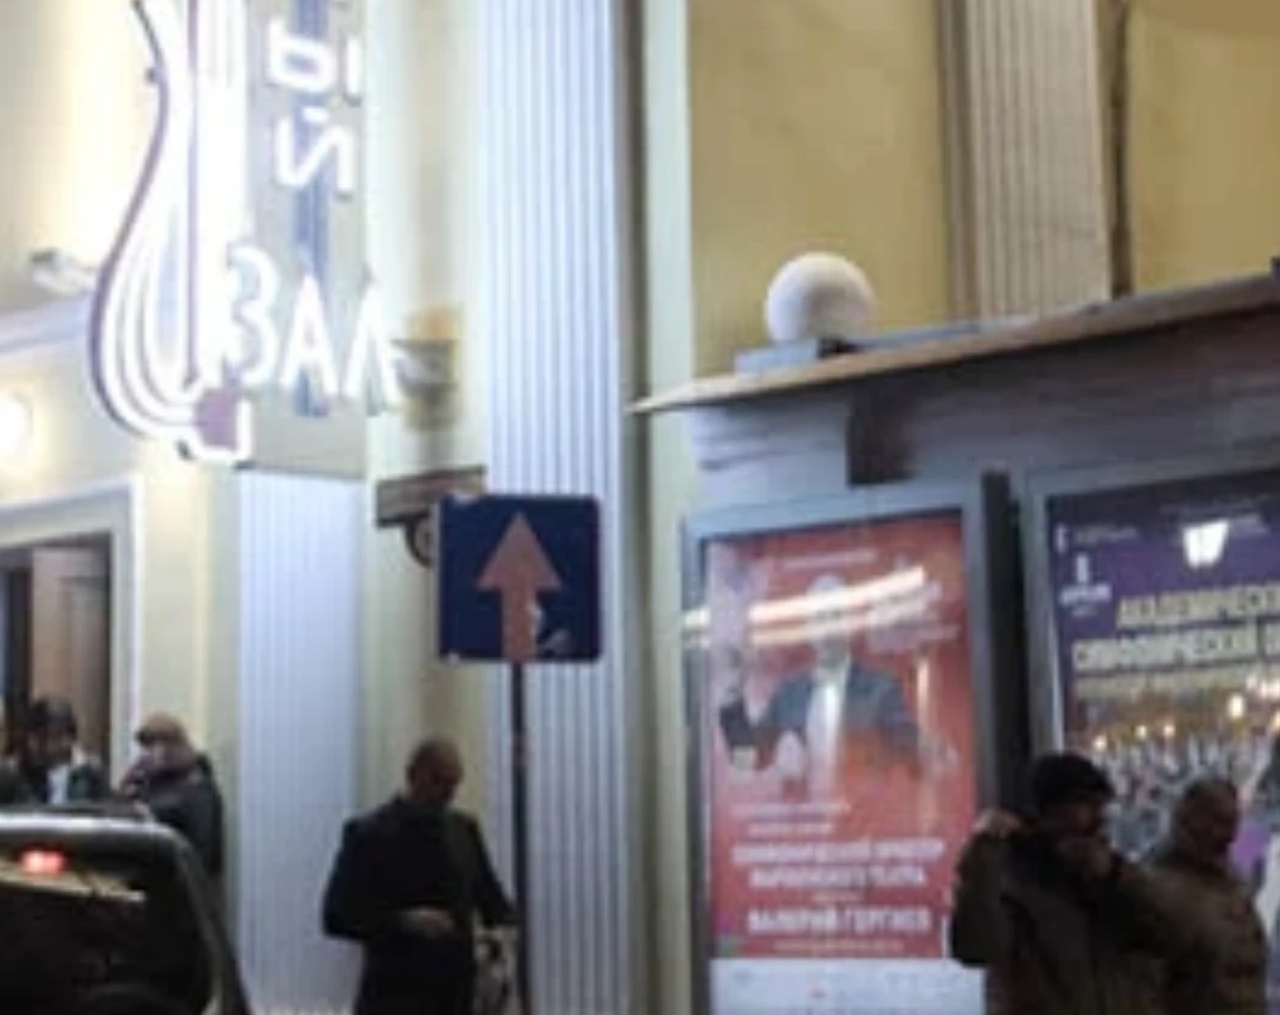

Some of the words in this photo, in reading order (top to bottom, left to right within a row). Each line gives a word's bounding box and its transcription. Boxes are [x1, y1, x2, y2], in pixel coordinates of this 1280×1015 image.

[224, 242, 401, 408] ЗАЛ
[1072, 616, 1260, 672] СИМФОНИЧЕСКИЙ
[747, 904, 837, 935] ВАЛЕРИЙ
[843, 903, 932, 933] ГЕРГИЕВ
